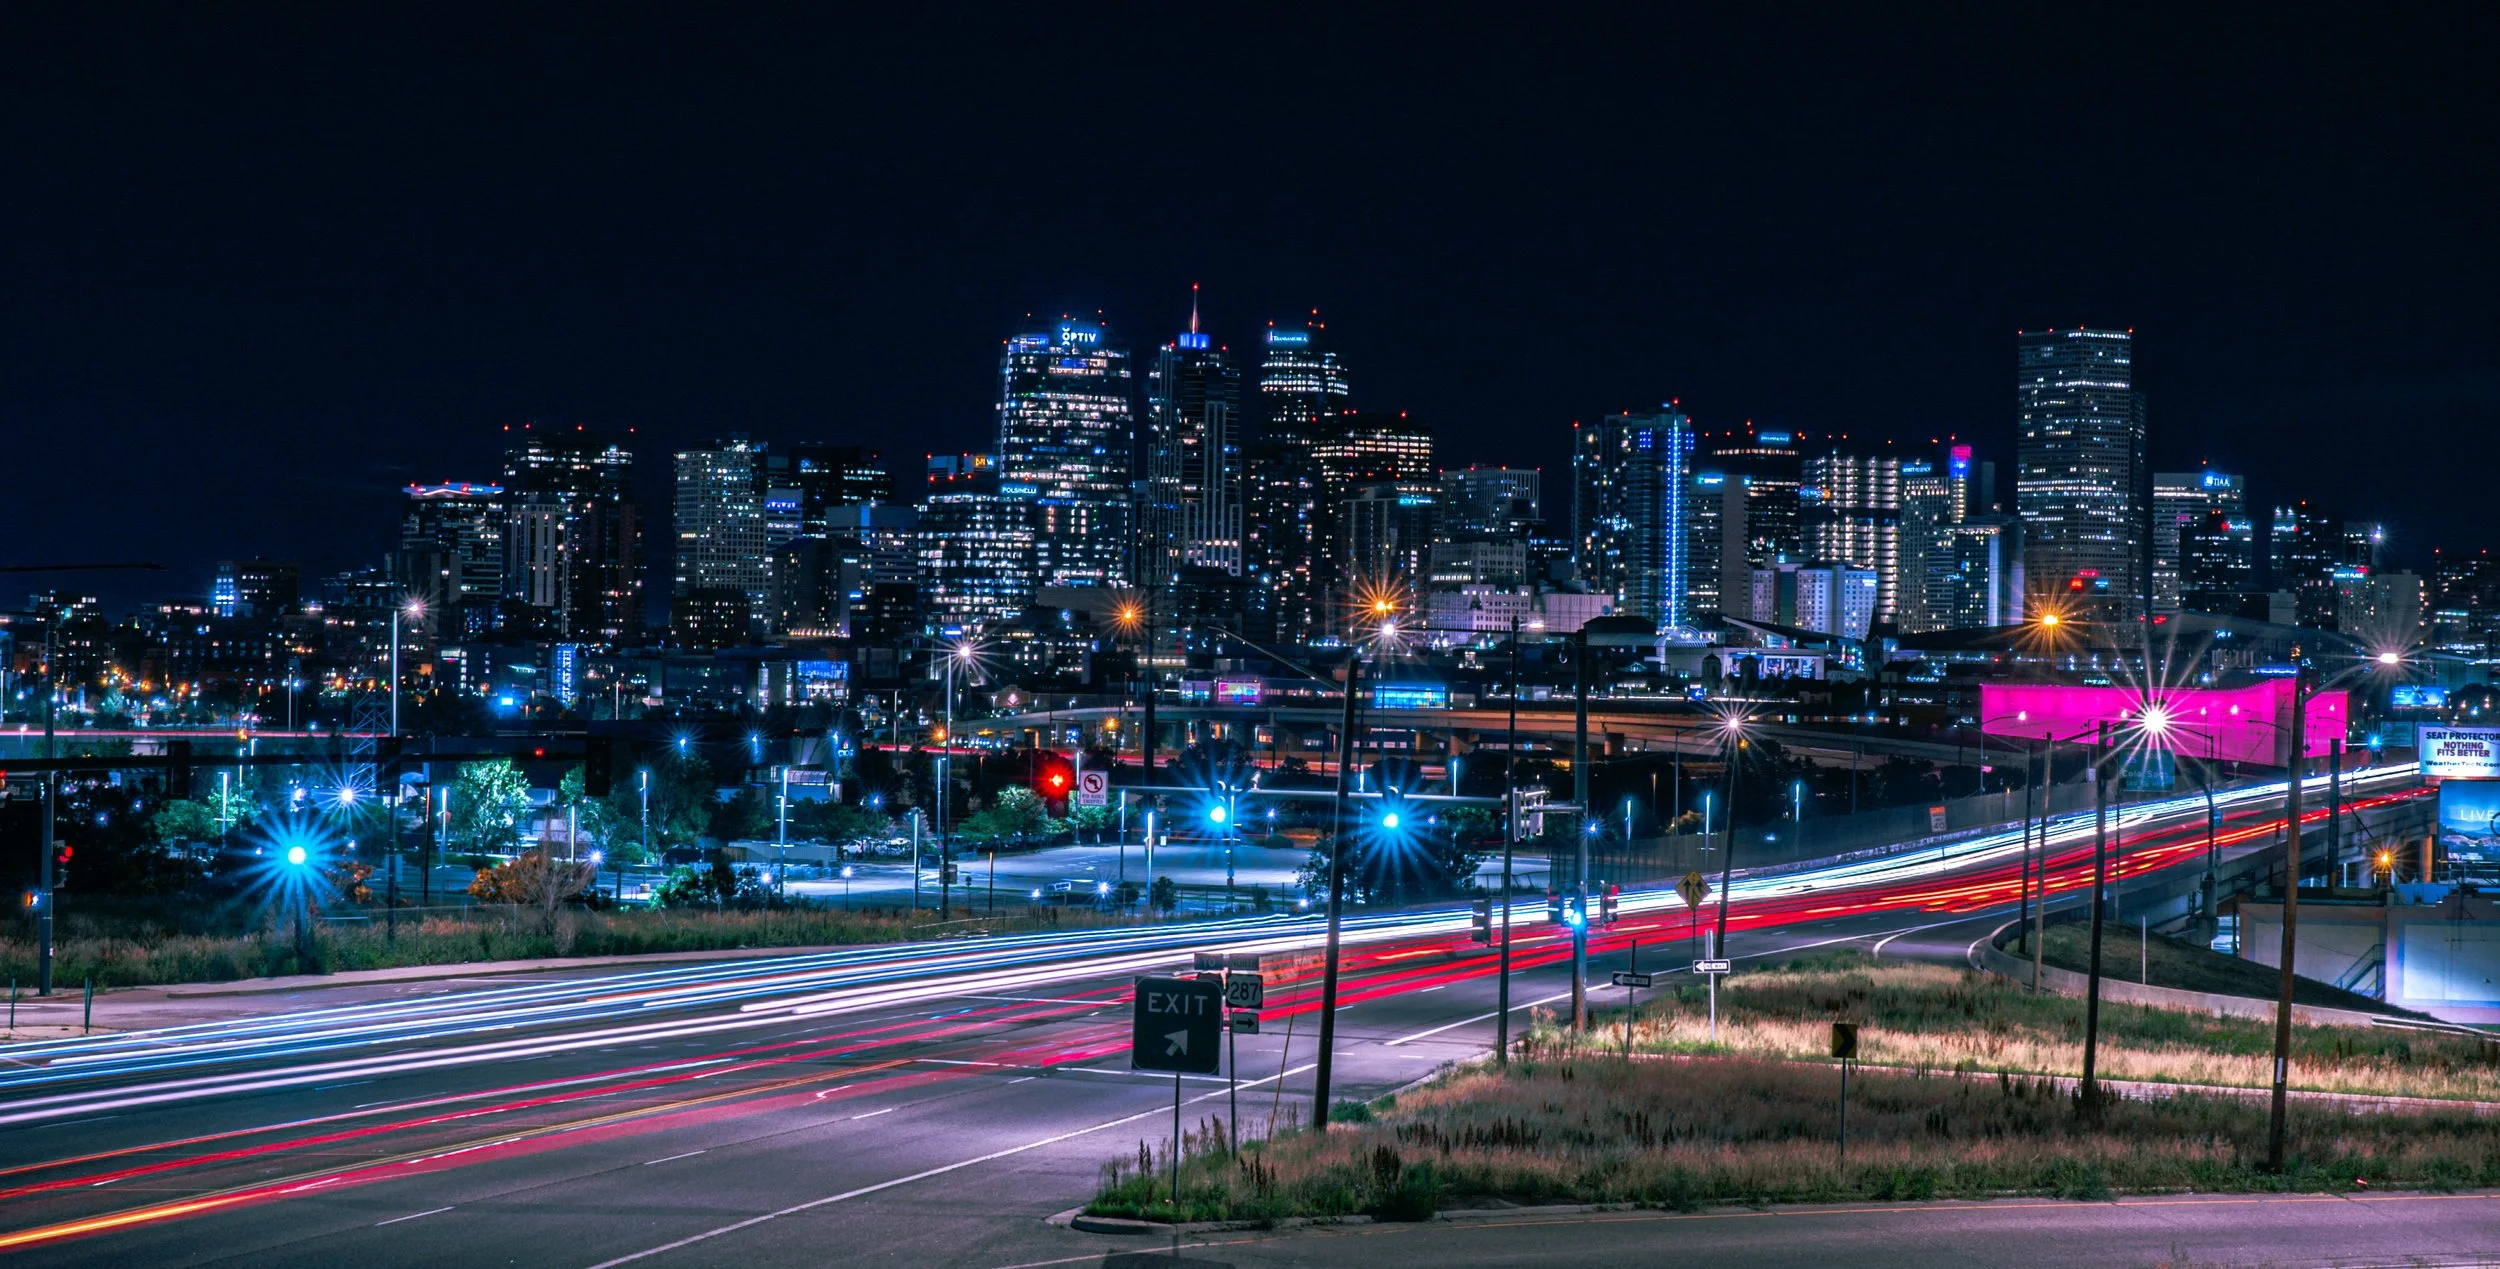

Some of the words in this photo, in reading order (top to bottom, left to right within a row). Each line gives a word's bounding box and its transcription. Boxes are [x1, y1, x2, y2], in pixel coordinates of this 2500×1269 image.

[1062, 330, 1096, 344] OPTIV
[1002, 486, 1037, 494] POLSINELLI
[2426, 732, 2448, 740] SEAT
[2444, 742, 2484, 750] NOTHING
[2458, 749, 2490, 757] BETTER
[2461, 810, 2494, 820] LIVE
[1203, 958, 1216, 967] TO
[1230, 982, 1258, 1001] 287
[1148, 992, 1208, 1015] EXIT
